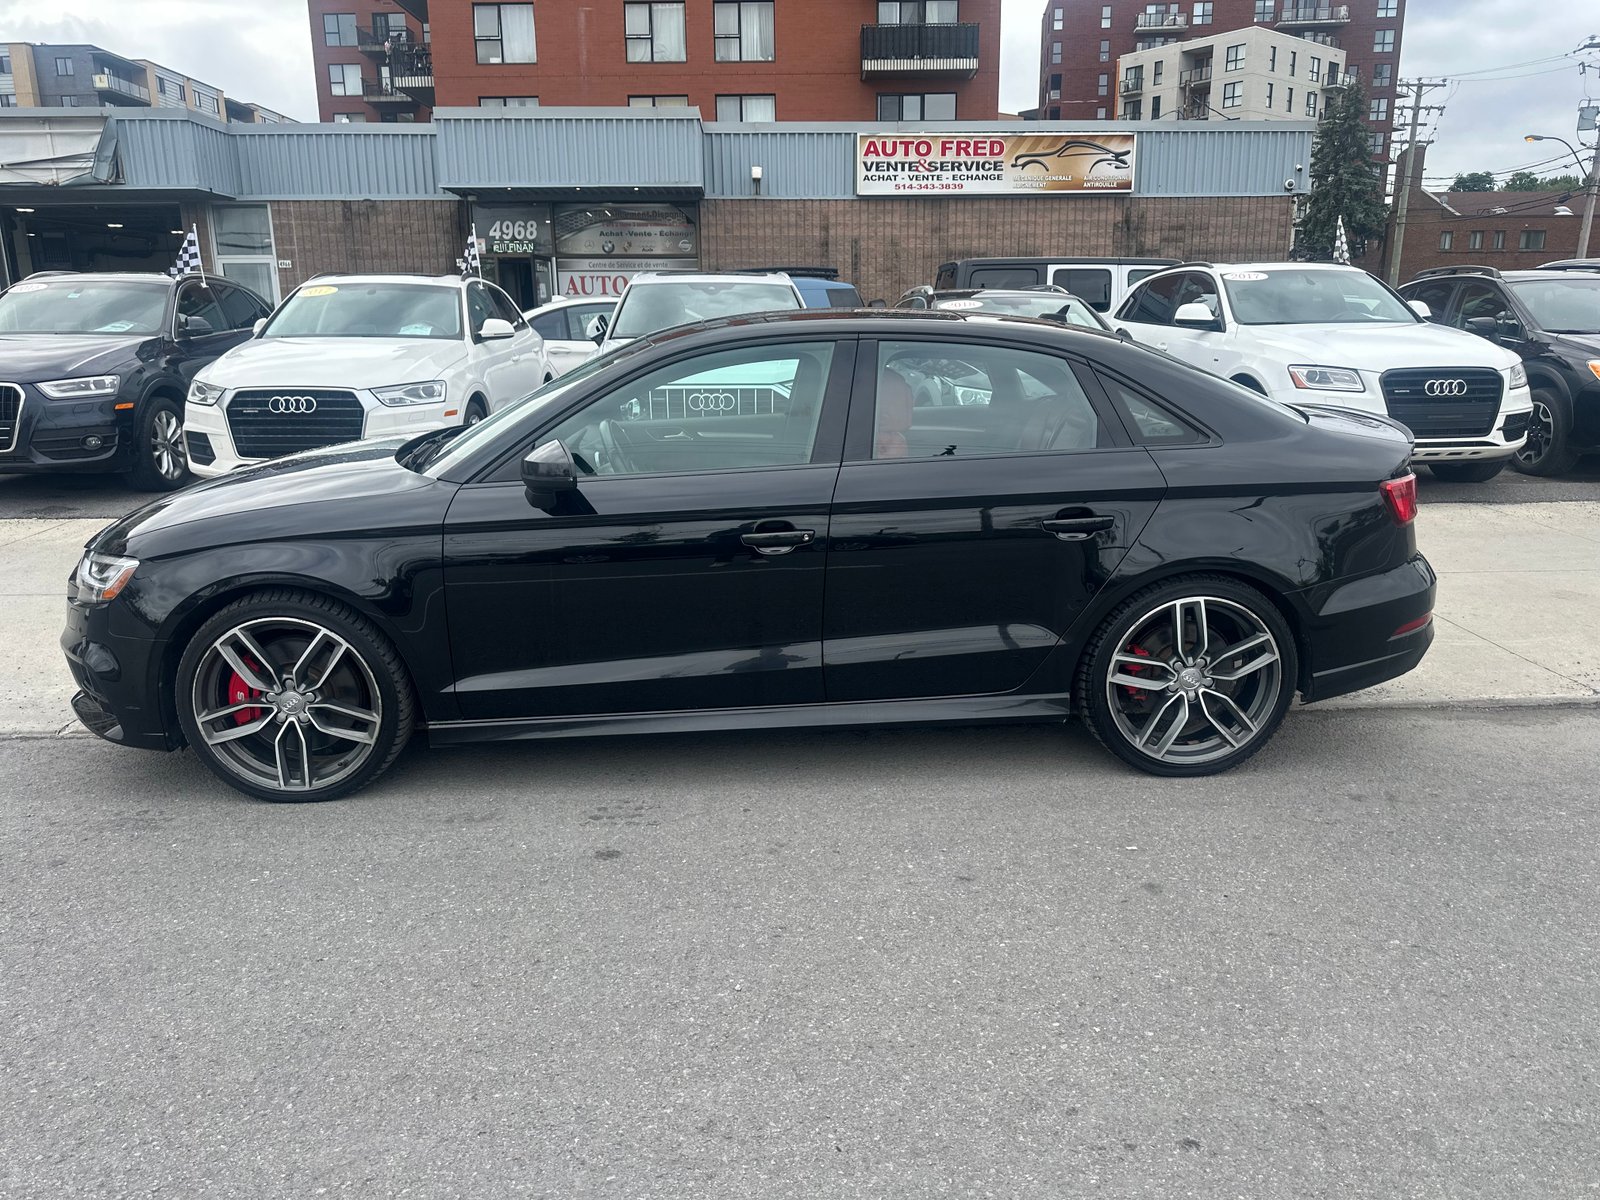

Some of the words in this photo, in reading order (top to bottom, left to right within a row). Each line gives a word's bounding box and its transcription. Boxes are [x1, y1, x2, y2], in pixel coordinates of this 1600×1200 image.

[863, 140, 932, 157] AUTO
[940, 140, 1005, 157] FRED
[489, 220, 537, 240] 4968
[588, 261, 607, 269] Centre
[565, 274, 629, 296] AUTO
